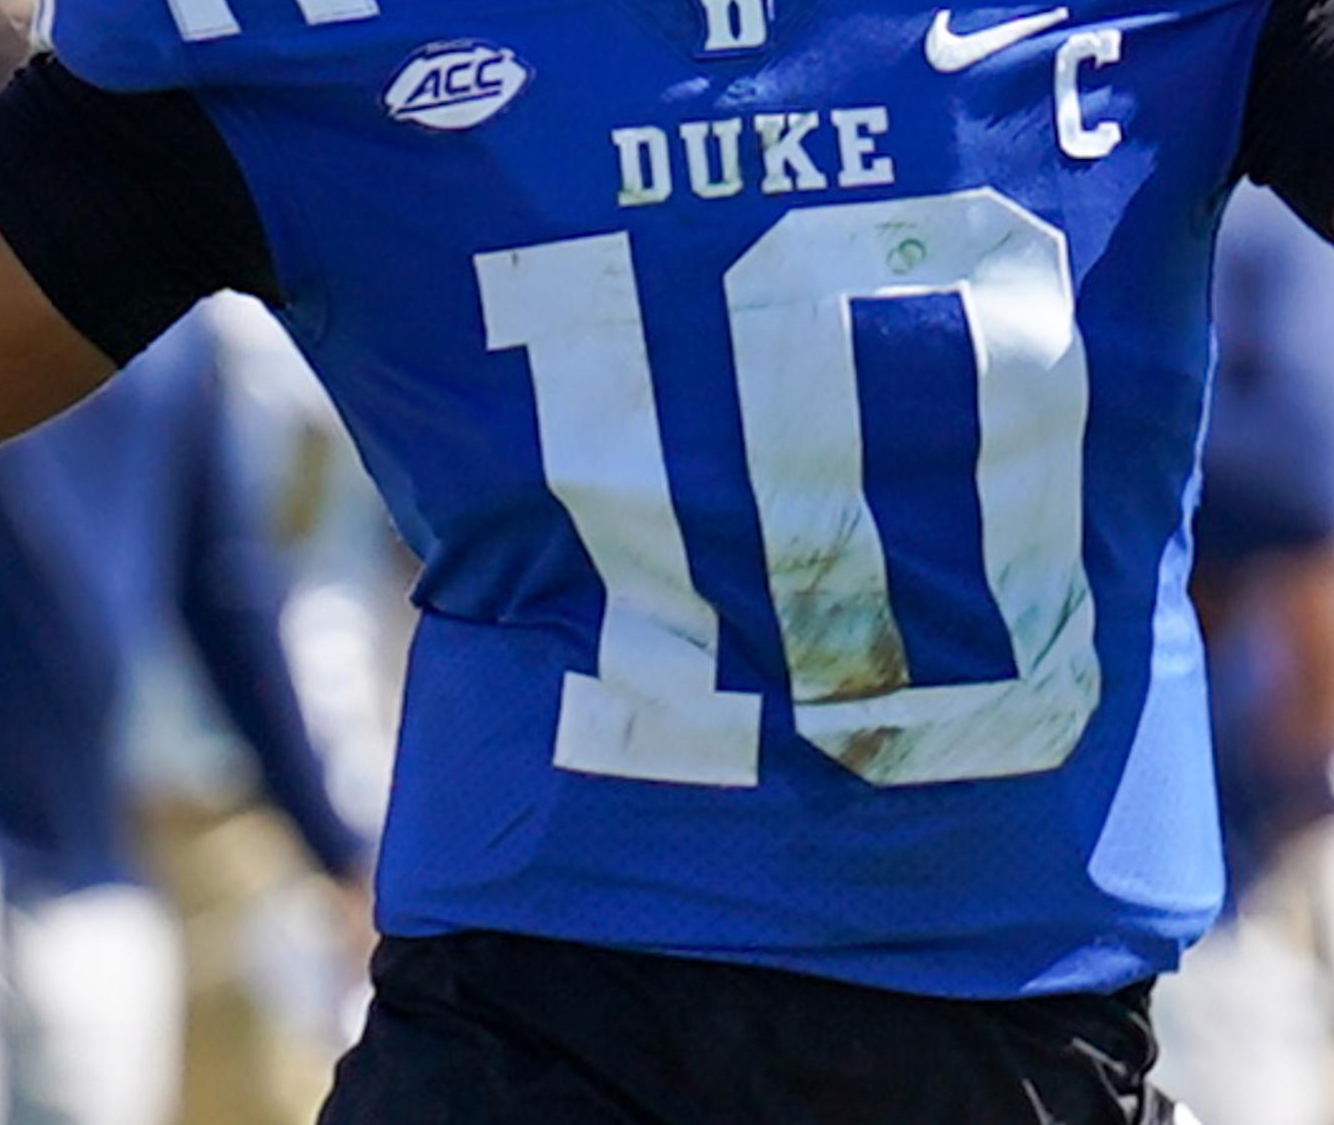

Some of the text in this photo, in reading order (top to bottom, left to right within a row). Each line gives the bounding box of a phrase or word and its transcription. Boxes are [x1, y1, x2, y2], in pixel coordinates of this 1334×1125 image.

[404, 56, 504, 105] ACC
[1054, 28, 1122, 160] C
[611, 106, 895, 207] DUKE
[473, 185, 1101, 788] 10
